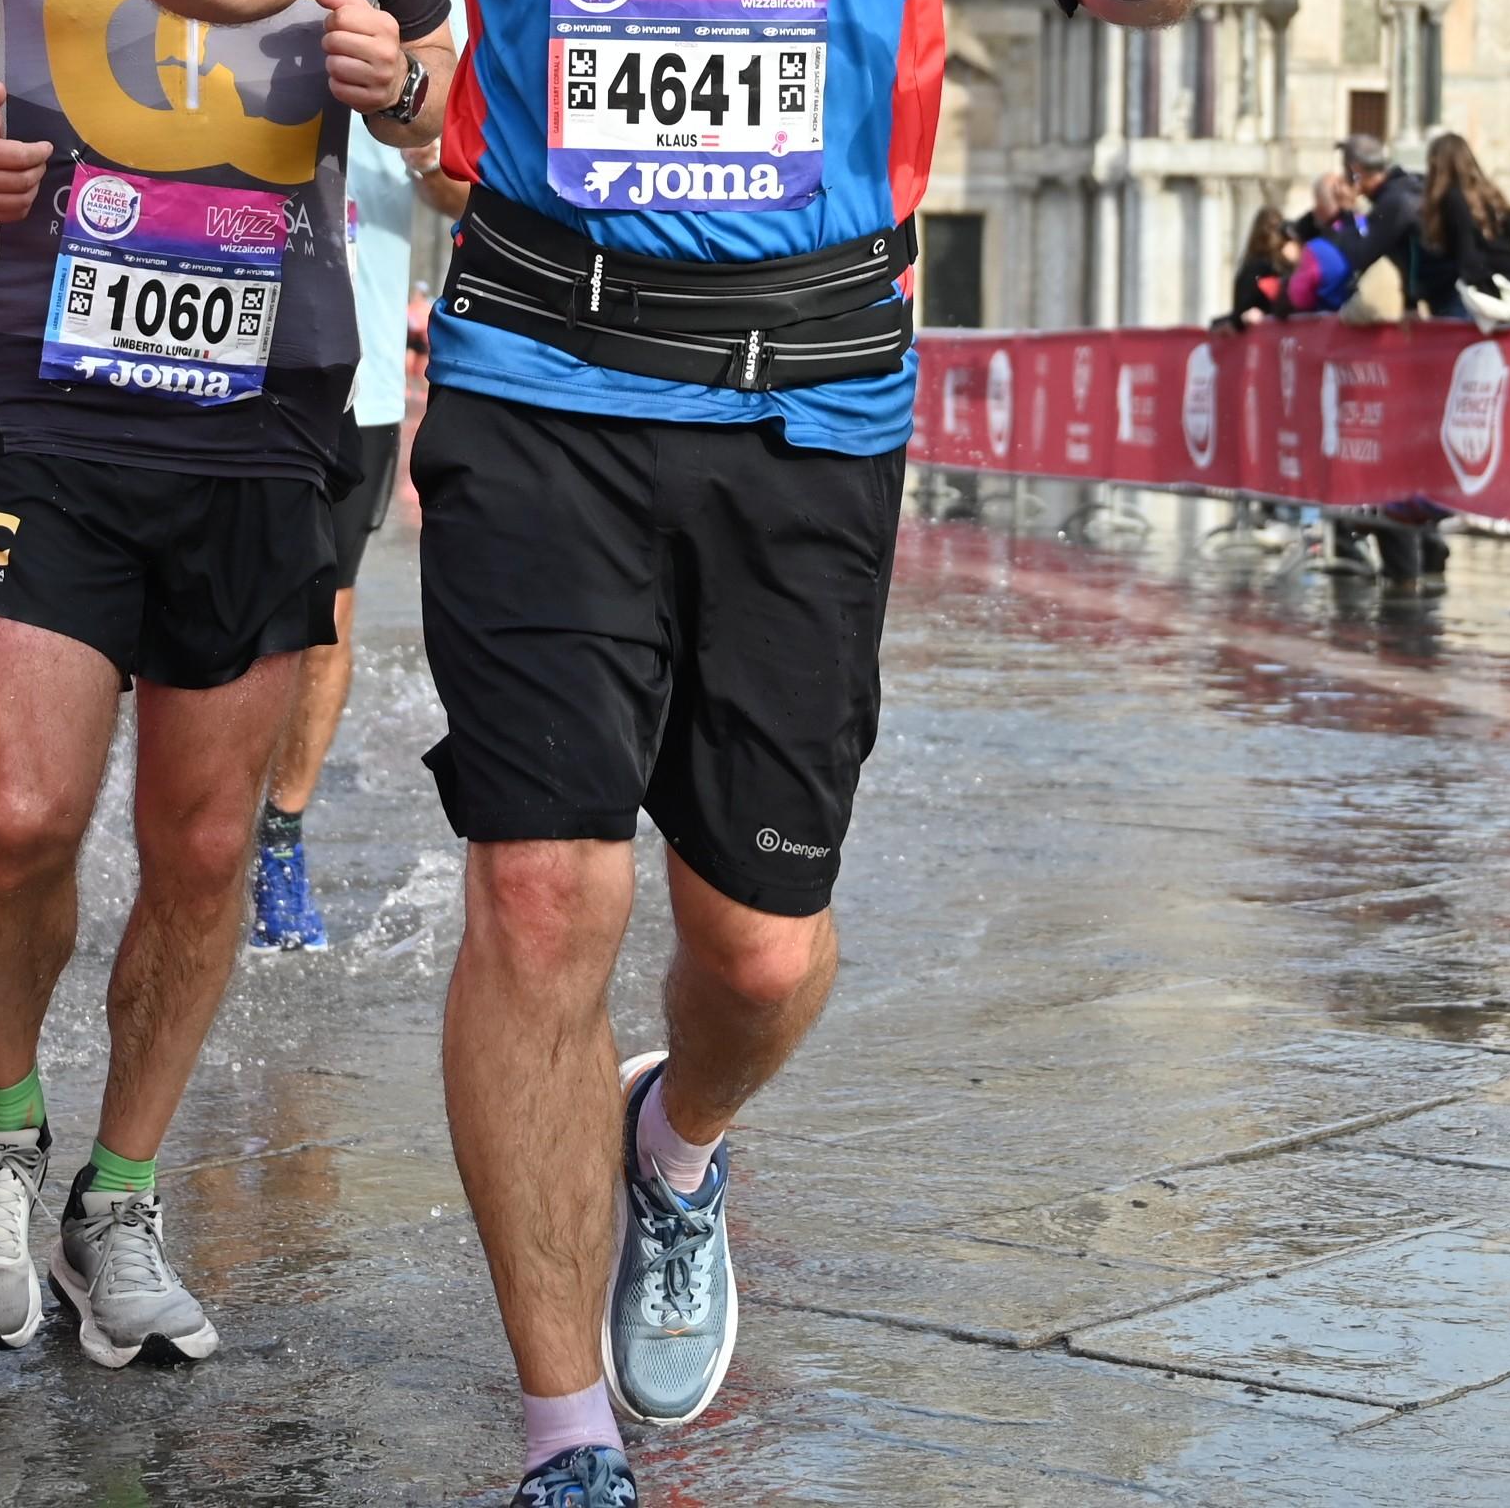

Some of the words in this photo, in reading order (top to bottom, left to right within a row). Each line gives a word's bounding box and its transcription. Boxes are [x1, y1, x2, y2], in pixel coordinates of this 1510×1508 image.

[607, 52, 762, 126] 4641
[656, 133, 698, 148] KLAUS
[811, 136, 819, 144] 4
[94, 187, 113, 197] WIZZ
[87, 200, 128, 215] MARATHON
[89, 193, 129, 209] VENICE
[219, 242, 276, 255] wizzair.com
[107, 274, 233, 344] 1060
[113, 336, 163, 354] UMBERTO
[165, 344, 192, 357] LUIGI
[781, 837, 832, 859] benger
